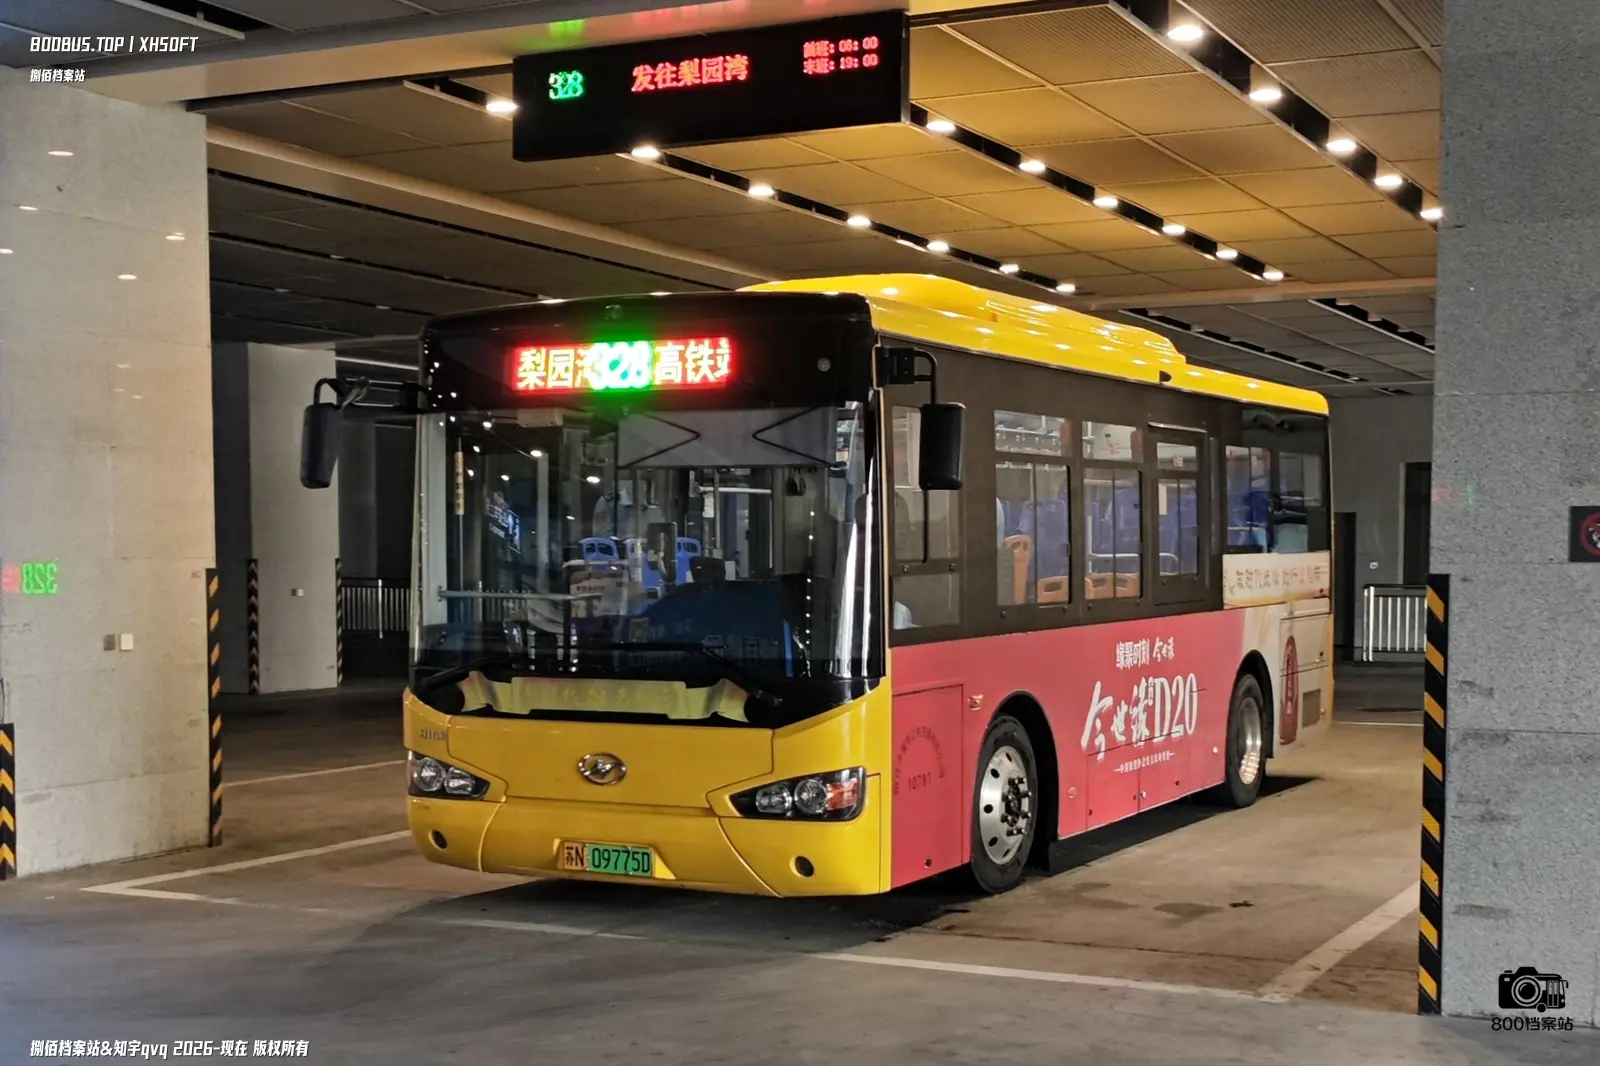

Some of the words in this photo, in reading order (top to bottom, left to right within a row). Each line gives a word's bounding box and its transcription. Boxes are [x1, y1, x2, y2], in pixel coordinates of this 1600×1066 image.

[549, 70, 584, 100] 328
[631, 54, 749, 93] 发往梨园湾
[589, 341, 653, 390] 328
[591, 847, 651, 873] 09775D
